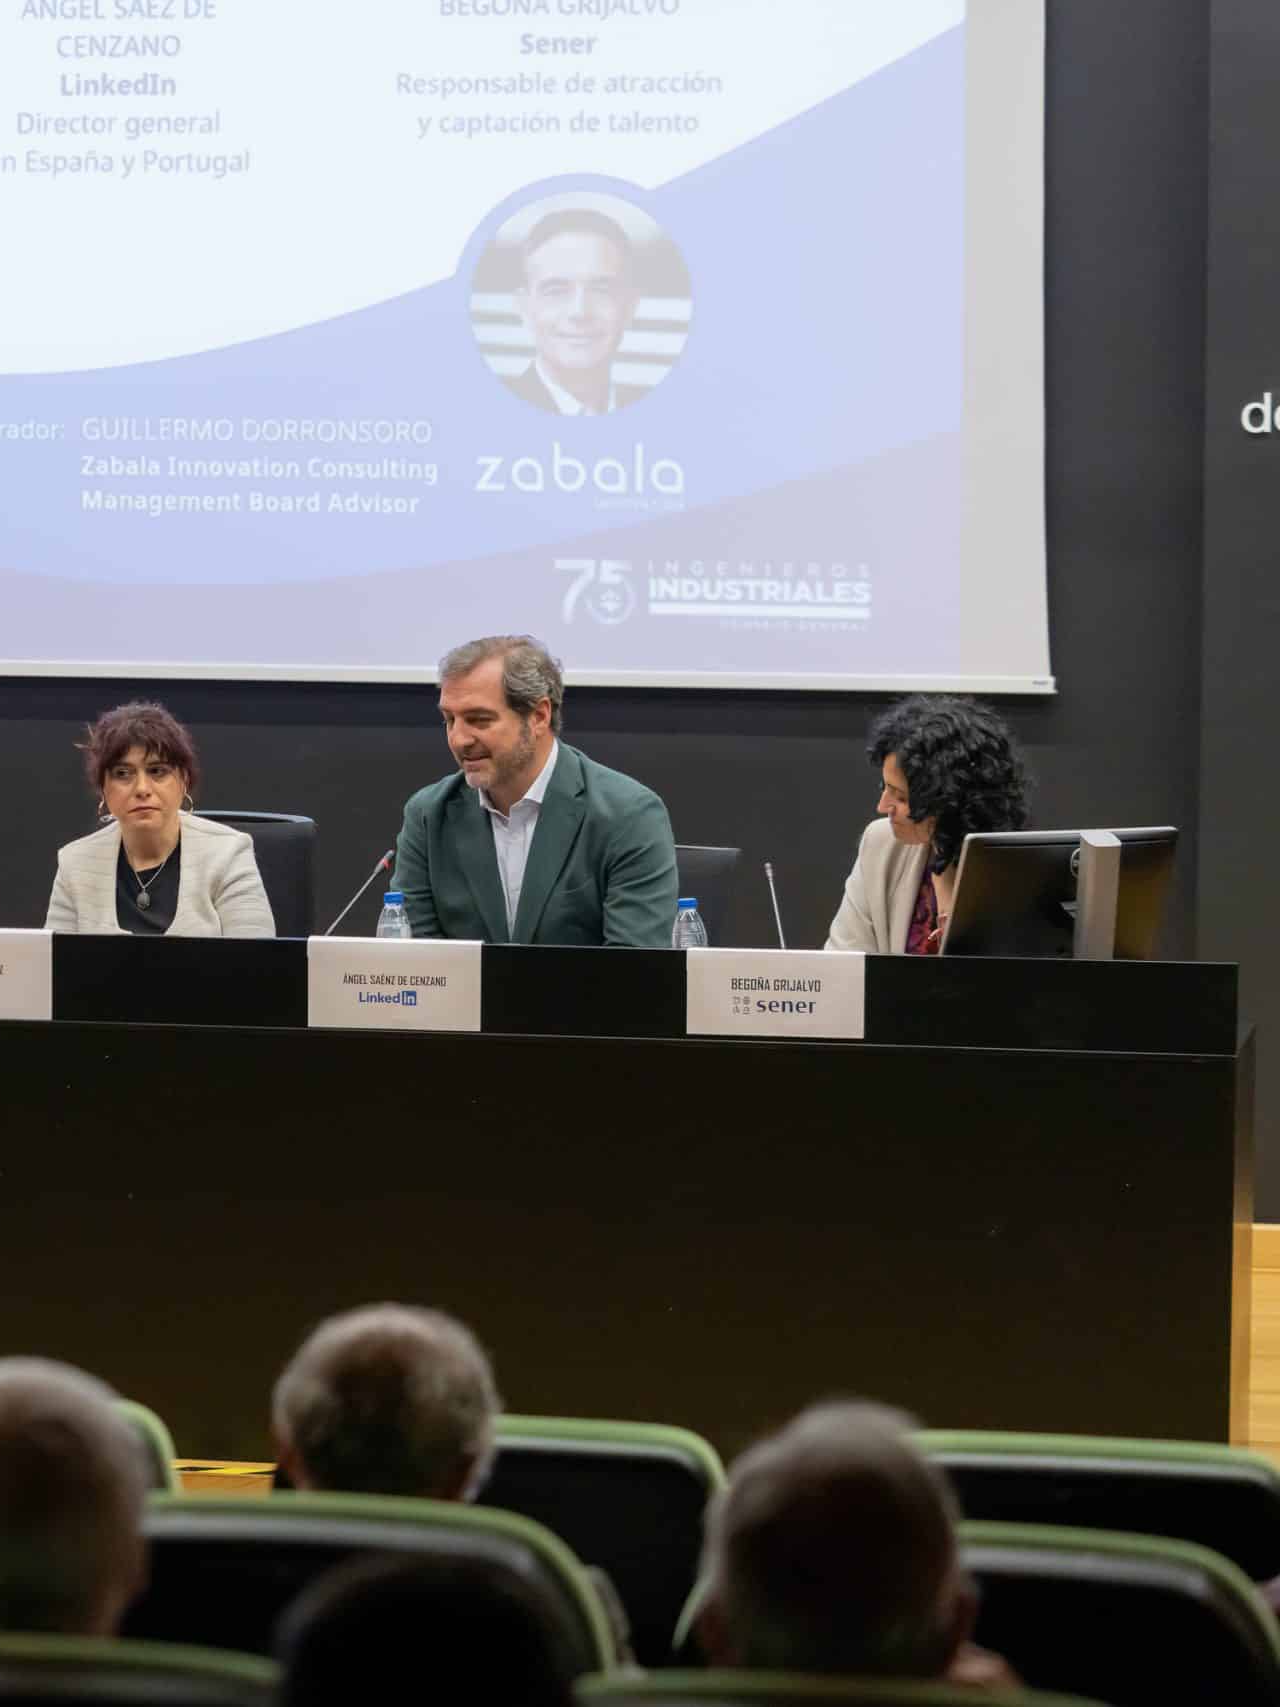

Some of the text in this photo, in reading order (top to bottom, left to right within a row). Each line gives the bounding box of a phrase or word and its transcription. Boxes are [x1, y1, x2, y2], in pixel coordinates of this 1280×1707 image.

[56, 34, 181, 60] CENZANO
[519, 32, 597, 56] Sener
[60, 71, 177, 97] LinkedIn
[396, 71, 723, 100] Responsable de atracción
[16, 110, 221, 141] Director general
[416, 110, 700, 140] y captación de talento
[25, 149, 114, 178] España
[121, 154, 136, 180] y
[143, 148, 250, 180] Portugal
[79, 415, 234, 441] GUILLERMO
[242, 418, 433, 444] DORRONSORO
[80, 455, 438, 486] Zabala Innovation Consulting
[475, 441, 686, 495] zabala
[79, 489, 419, 517] Management Board Advisor
[554, 558, 636, 625] 75
[648, 578, 872, 602] INDUSTRIALES
[397, 975, 409, 986] DE
[410, 975, 447, 987] CENZANO
[731, 975, 821, 993] BEGOÑA GRIJALVO
[358, 990, 417, 1006] LinkedIn
[755, 999, 817, 1014] sener
